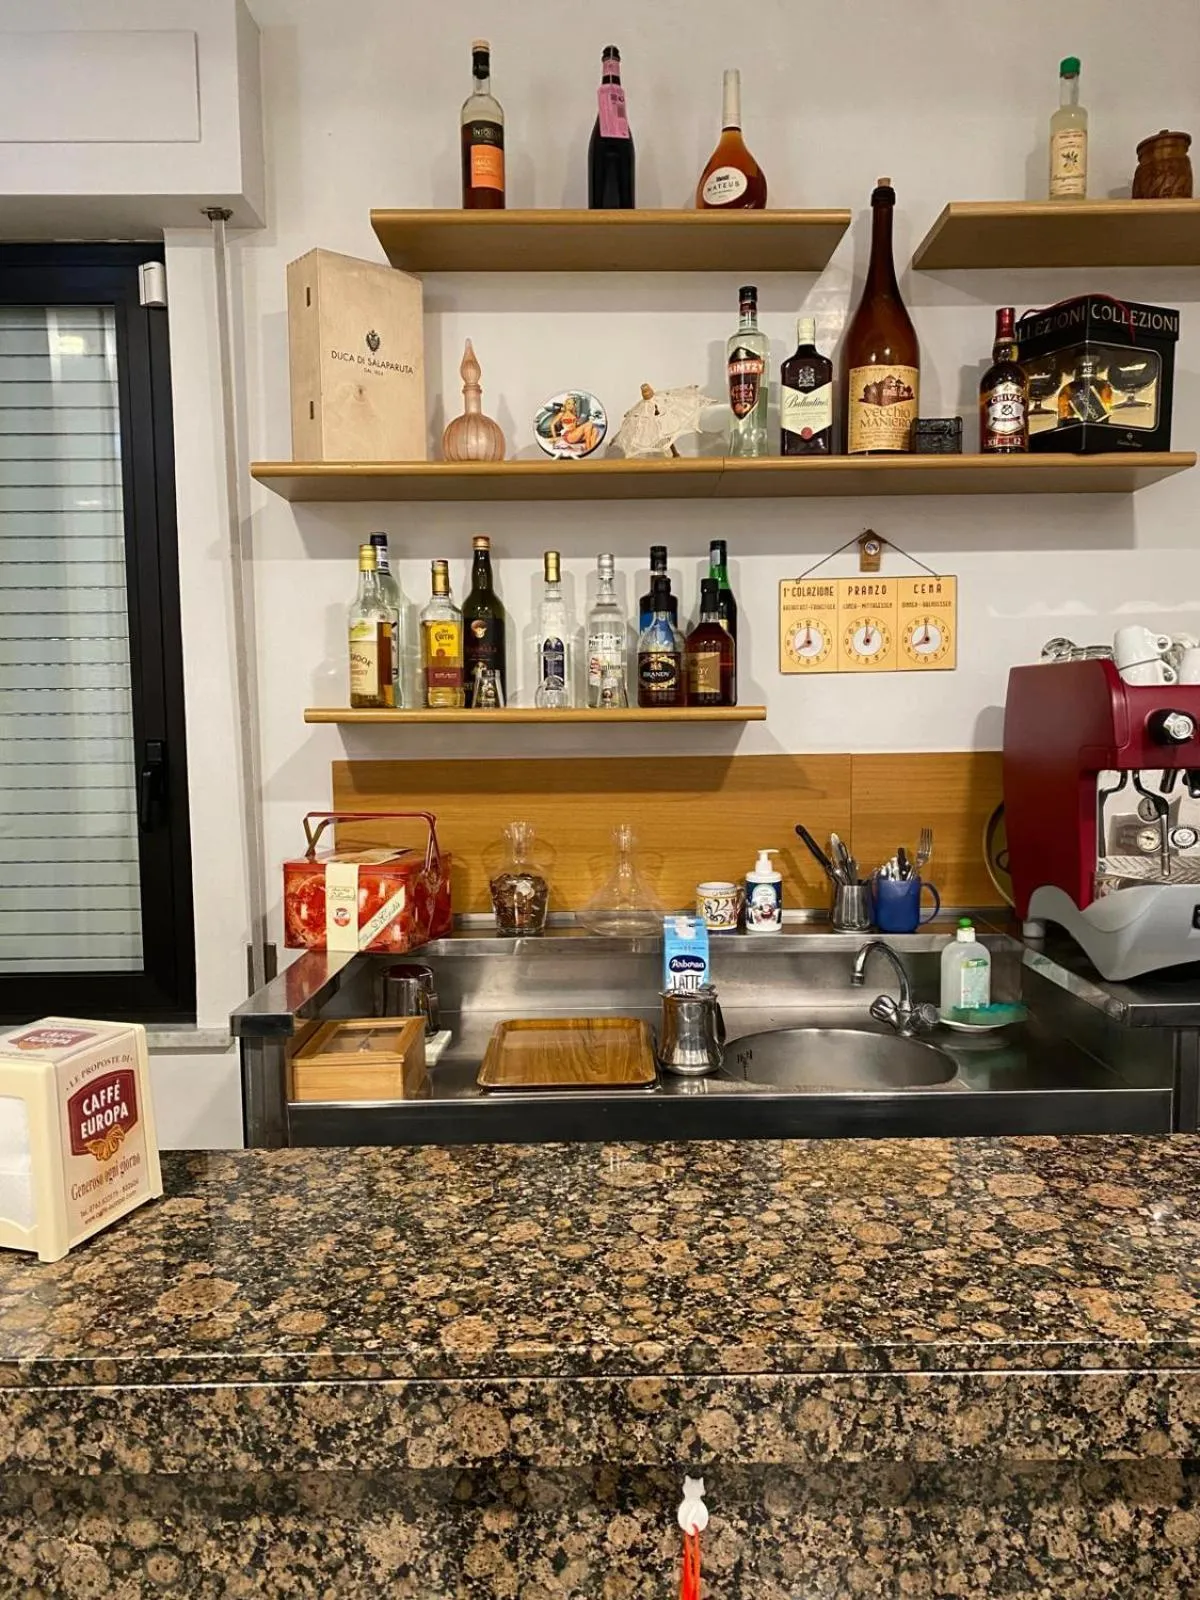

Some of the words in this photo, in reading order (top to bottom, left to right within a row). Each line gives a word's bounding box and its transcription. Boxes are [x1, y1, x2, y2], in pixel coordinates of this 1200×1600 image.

[1018, 305, 1085, 342] LLEZIONI
[1091, 303, 1178, 332] COLLEZIONI
[331, 350, 355, 362] DUCA
[357, 356, 365, 364] DI
[367, 358, 414, 375] SALAPARUTA
[991, 394, 1022, 404] CHIVAS
[791, 585, 835, 598] COLAZIONE
[847, 584, 887, 596] PRANZO
[913, 583, 942, 594] CENA
[673, 975, 702, 990] LATTE
[81, 1056, 119, 1078] PROPOSTE
[80, 1102, 129, 1139] EUROPA
